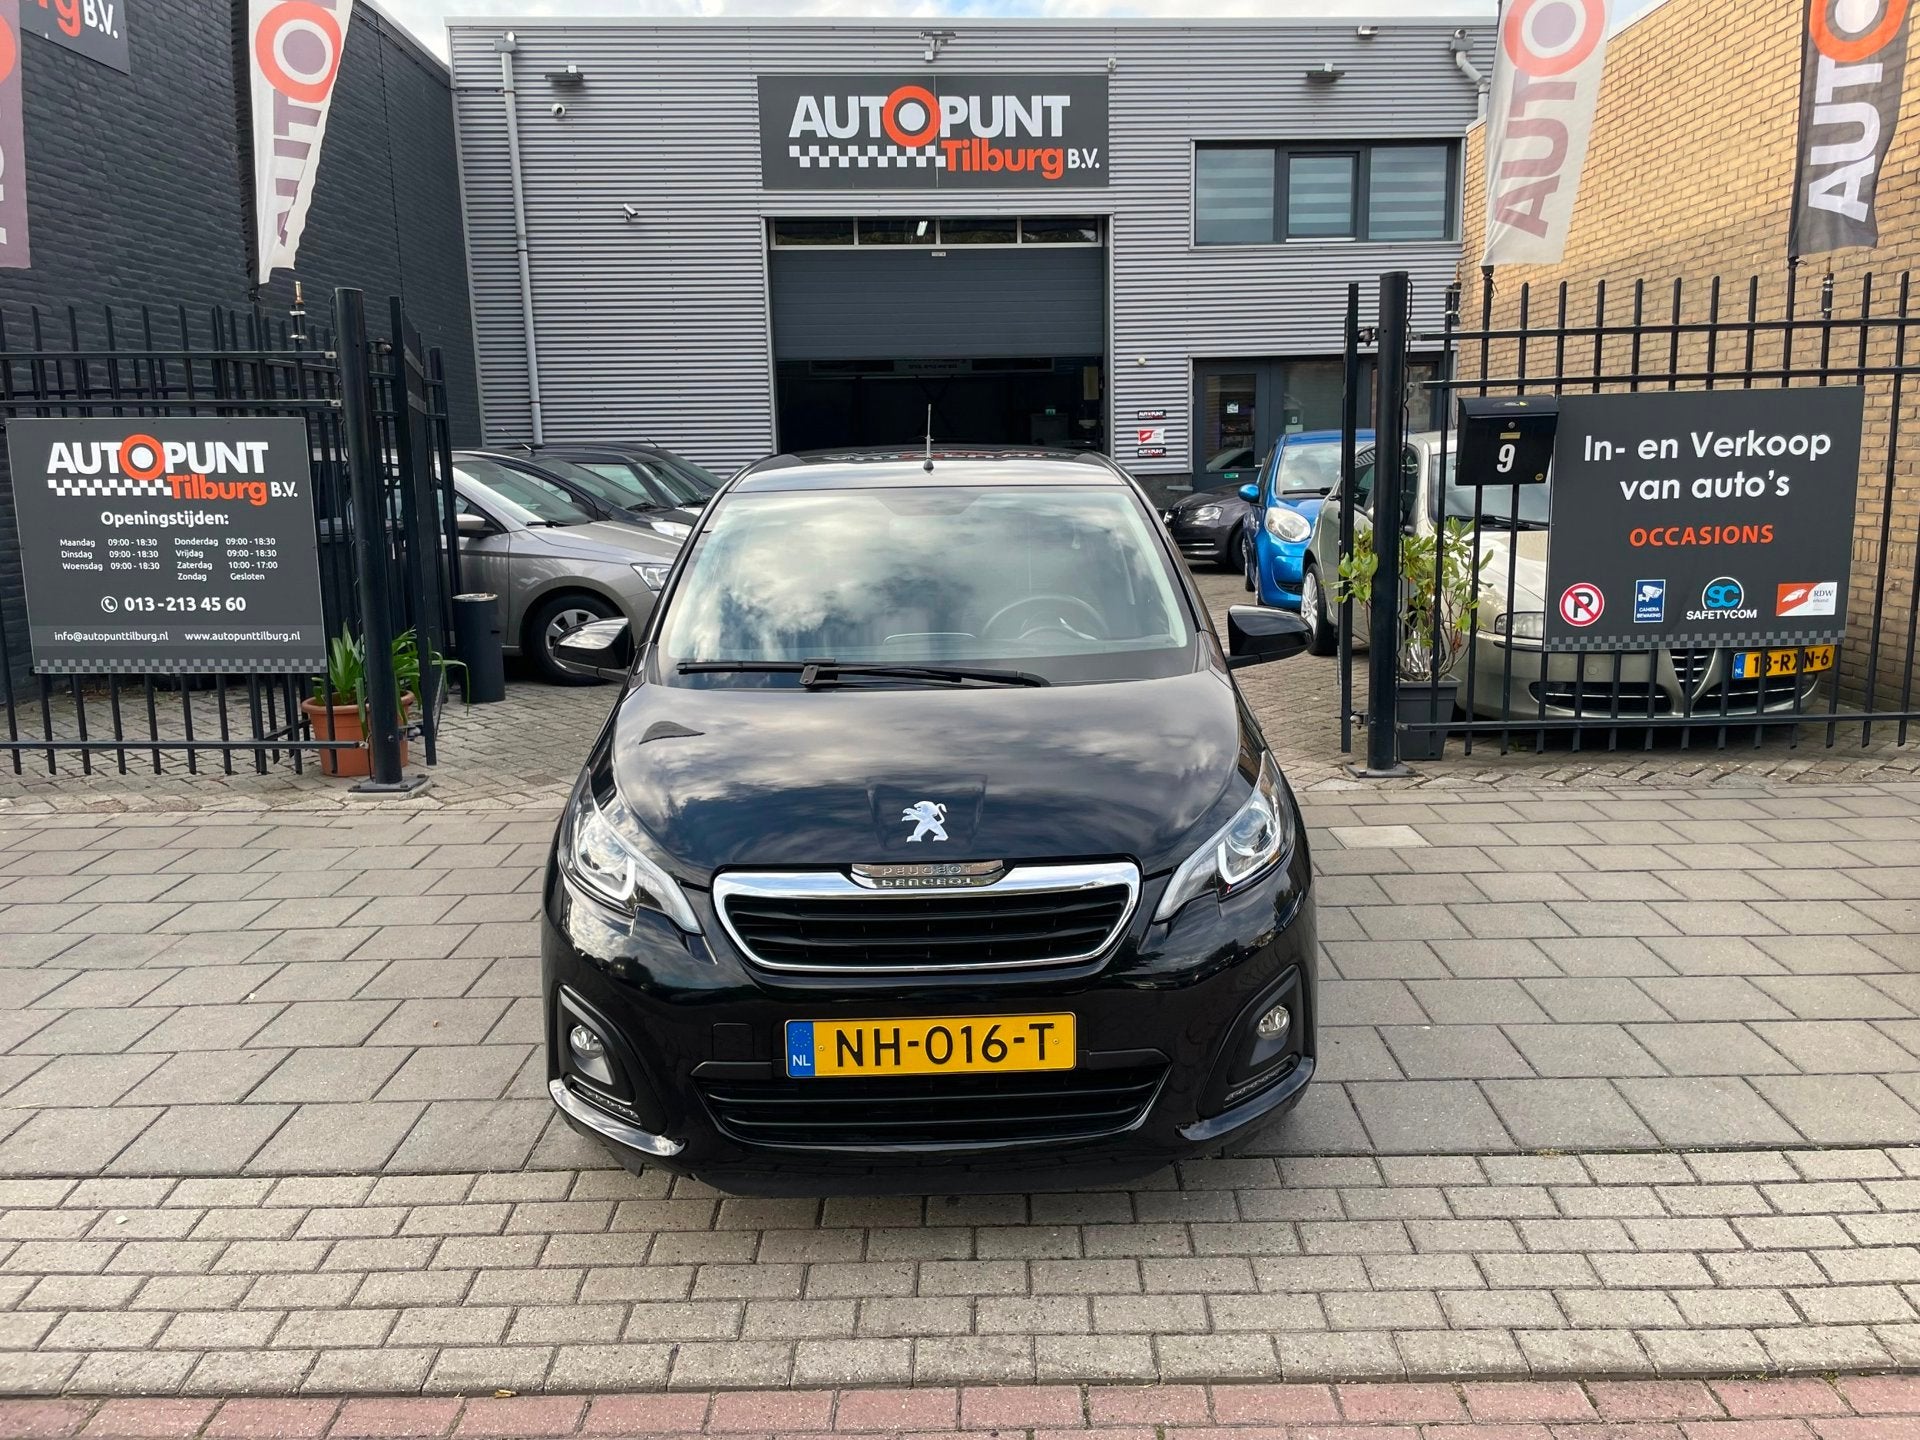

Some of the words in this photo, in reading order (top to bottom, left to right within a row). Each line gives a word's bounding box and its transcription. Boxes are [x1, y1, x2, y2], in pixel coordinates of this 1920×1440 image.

[789, 86, 1071, 147] AUTOPUNT
[941, 138, 1064, 180] Tilburg
[1068, 148, 1100, 168] B.V.
[1584, 436, 1625, 461] In-
[1637, 438, 1679, 460] en
[1690, 430, 1831, 461] Verkoop
[47, 434, 268, 480] AUTOPUNT
[1496, 444, 1515, 473] 9
[167, 474, 268, 506] Tilburg
[270, 481, 298, 498] B.V.
[1620, 478, 1680, 500] van
[1692, 470, 1790, 498] auto's
[101, 511, 229, 528] Openingstijden:
[175, 537, 219, 547] Donderdag
[1630, 525, 1774, 547] OCCASIONS
[60, 539, 95, 548] Maandag
[61, 551, 93, 559] Dinsdag
[175, 549, 204, 559] Vrijdag
[227, 549, 249, 557] 09:00
[255, 549, 277, 557] 18:30
[62, 562, 103, 571] Woensdag
[110, 562, 132, 570] 09:00
[139, 562, 160, 570] 18:30
[177, 561, 212, 570] Zaterdag
[177, 572, 207, 582] Zondag
[230, 572, 265, 580] Gesloten
[201, 597, 221, 611] 45
[225, 597, 246, 611] 60
[1686, 609, 1757, 620] SAFETYCOM
[54, 632, 168, 643] info@autopunttilburg.nl
[185, 631, 301, 642] www.autopunttilburg.nl
[882, 865, 972, 875] PEUGEOT
[836, 1022, 1055, 1068] NH-016-T
[792, 1055, 812, 1067] NL
